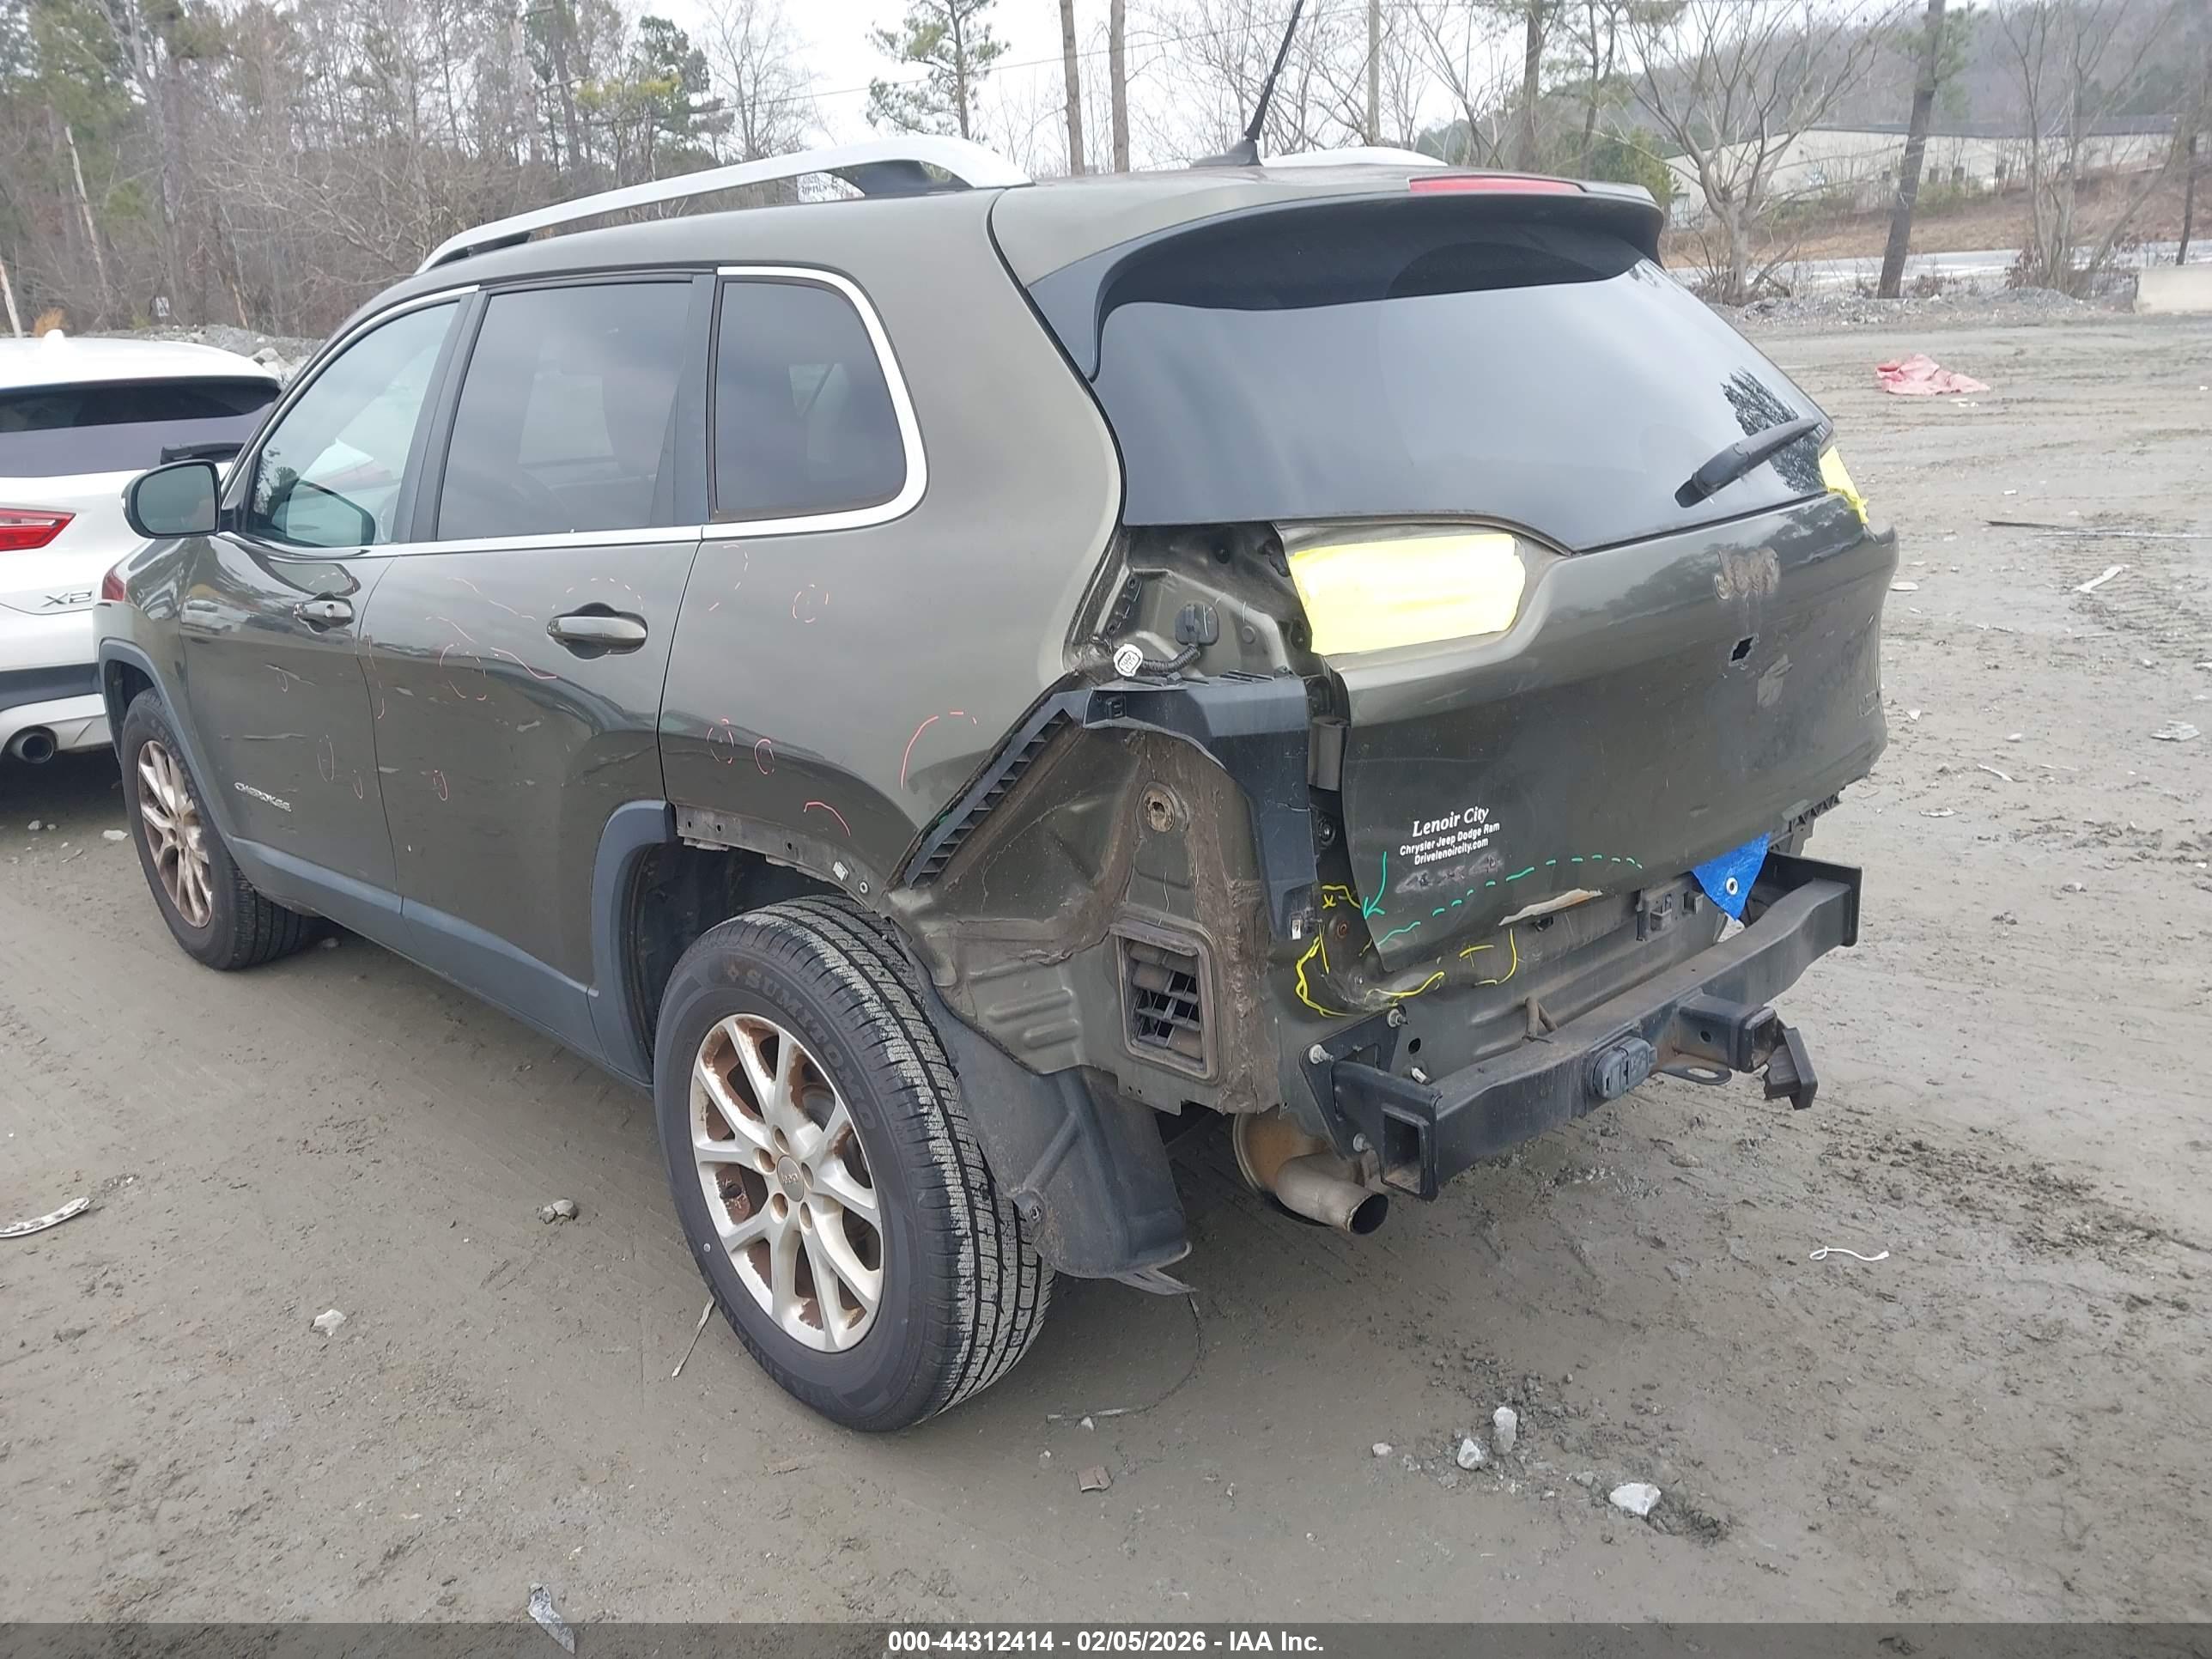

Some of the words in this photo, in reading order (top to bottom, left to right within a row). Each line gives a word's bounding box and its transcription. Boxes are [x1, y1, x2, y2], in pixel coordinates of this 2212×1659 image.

[1412, 811, 1462, 838] Lenoir
[1463, 805, 1490, 824] City
[1399, 839, 1437, 856] Chrysler
[1436, 835, 1456, 848] Jeep
[1457, 827, 1483, 842] Dodge
[1483, 822, 1501, 835] Ram
[1414, 837, 1490, 866] Drivelenoircity.com
